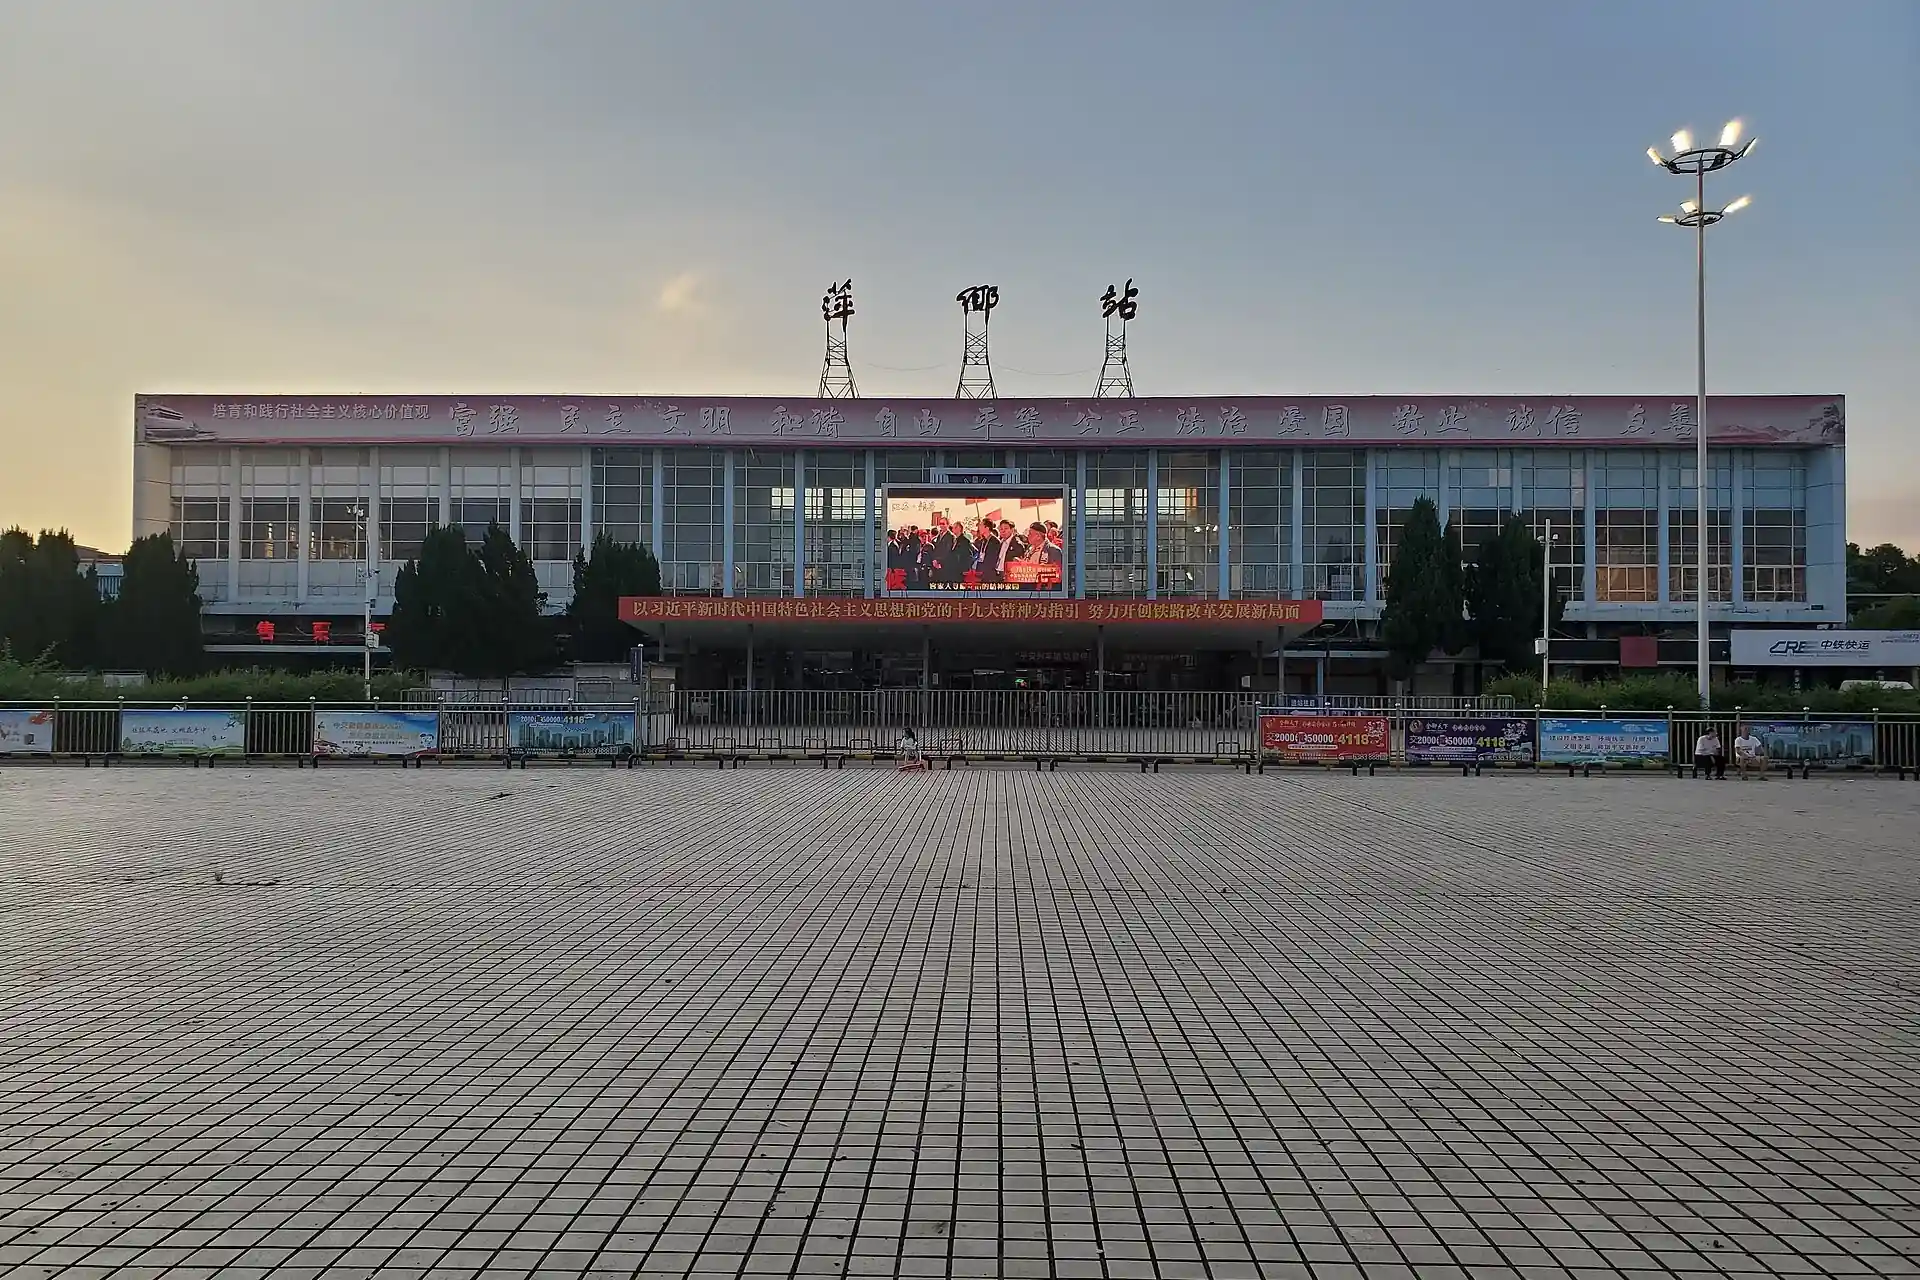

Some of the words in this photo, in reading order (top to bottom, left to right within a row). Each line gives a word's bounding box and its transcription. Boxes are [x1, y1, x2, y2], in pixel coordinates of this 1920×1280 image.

[212, 402, 430, 420] 培育和践行社会主义核心价值观
[450, 403, 521, 436] 富强
[559, 404, 631, 435] 民主
[662, 405, 733, 436] 文明
[771, 405, 845, 437] 和谐
[874, 406, 942, 437] 自由
[972, 407, 1043, 440] 平等
[1072, 410, 1145, 436] 公正
[1176, 405, 1249, 437] 法治
[1277, 404, 1351, 437] 爱国
[1391, 404, 1468, 437] 敬业
[1504, 403, 1583, 437] 诚信
[1619, 402, 1698, 439] 友善
[633, 600, 1079, 620] 以习近平新时代中国特色社会主义思想和党的十九大精神为指引
[1087, 602, 1300, 620] 努力开创铁路改革发展新局面
[1769, 640, 1817, 654] CRE
[1820, 639, 1871, 650] 中铁快运
[1338, 733, 1369, 745] 4118
[1476, 736, 1506, 747] 4118
